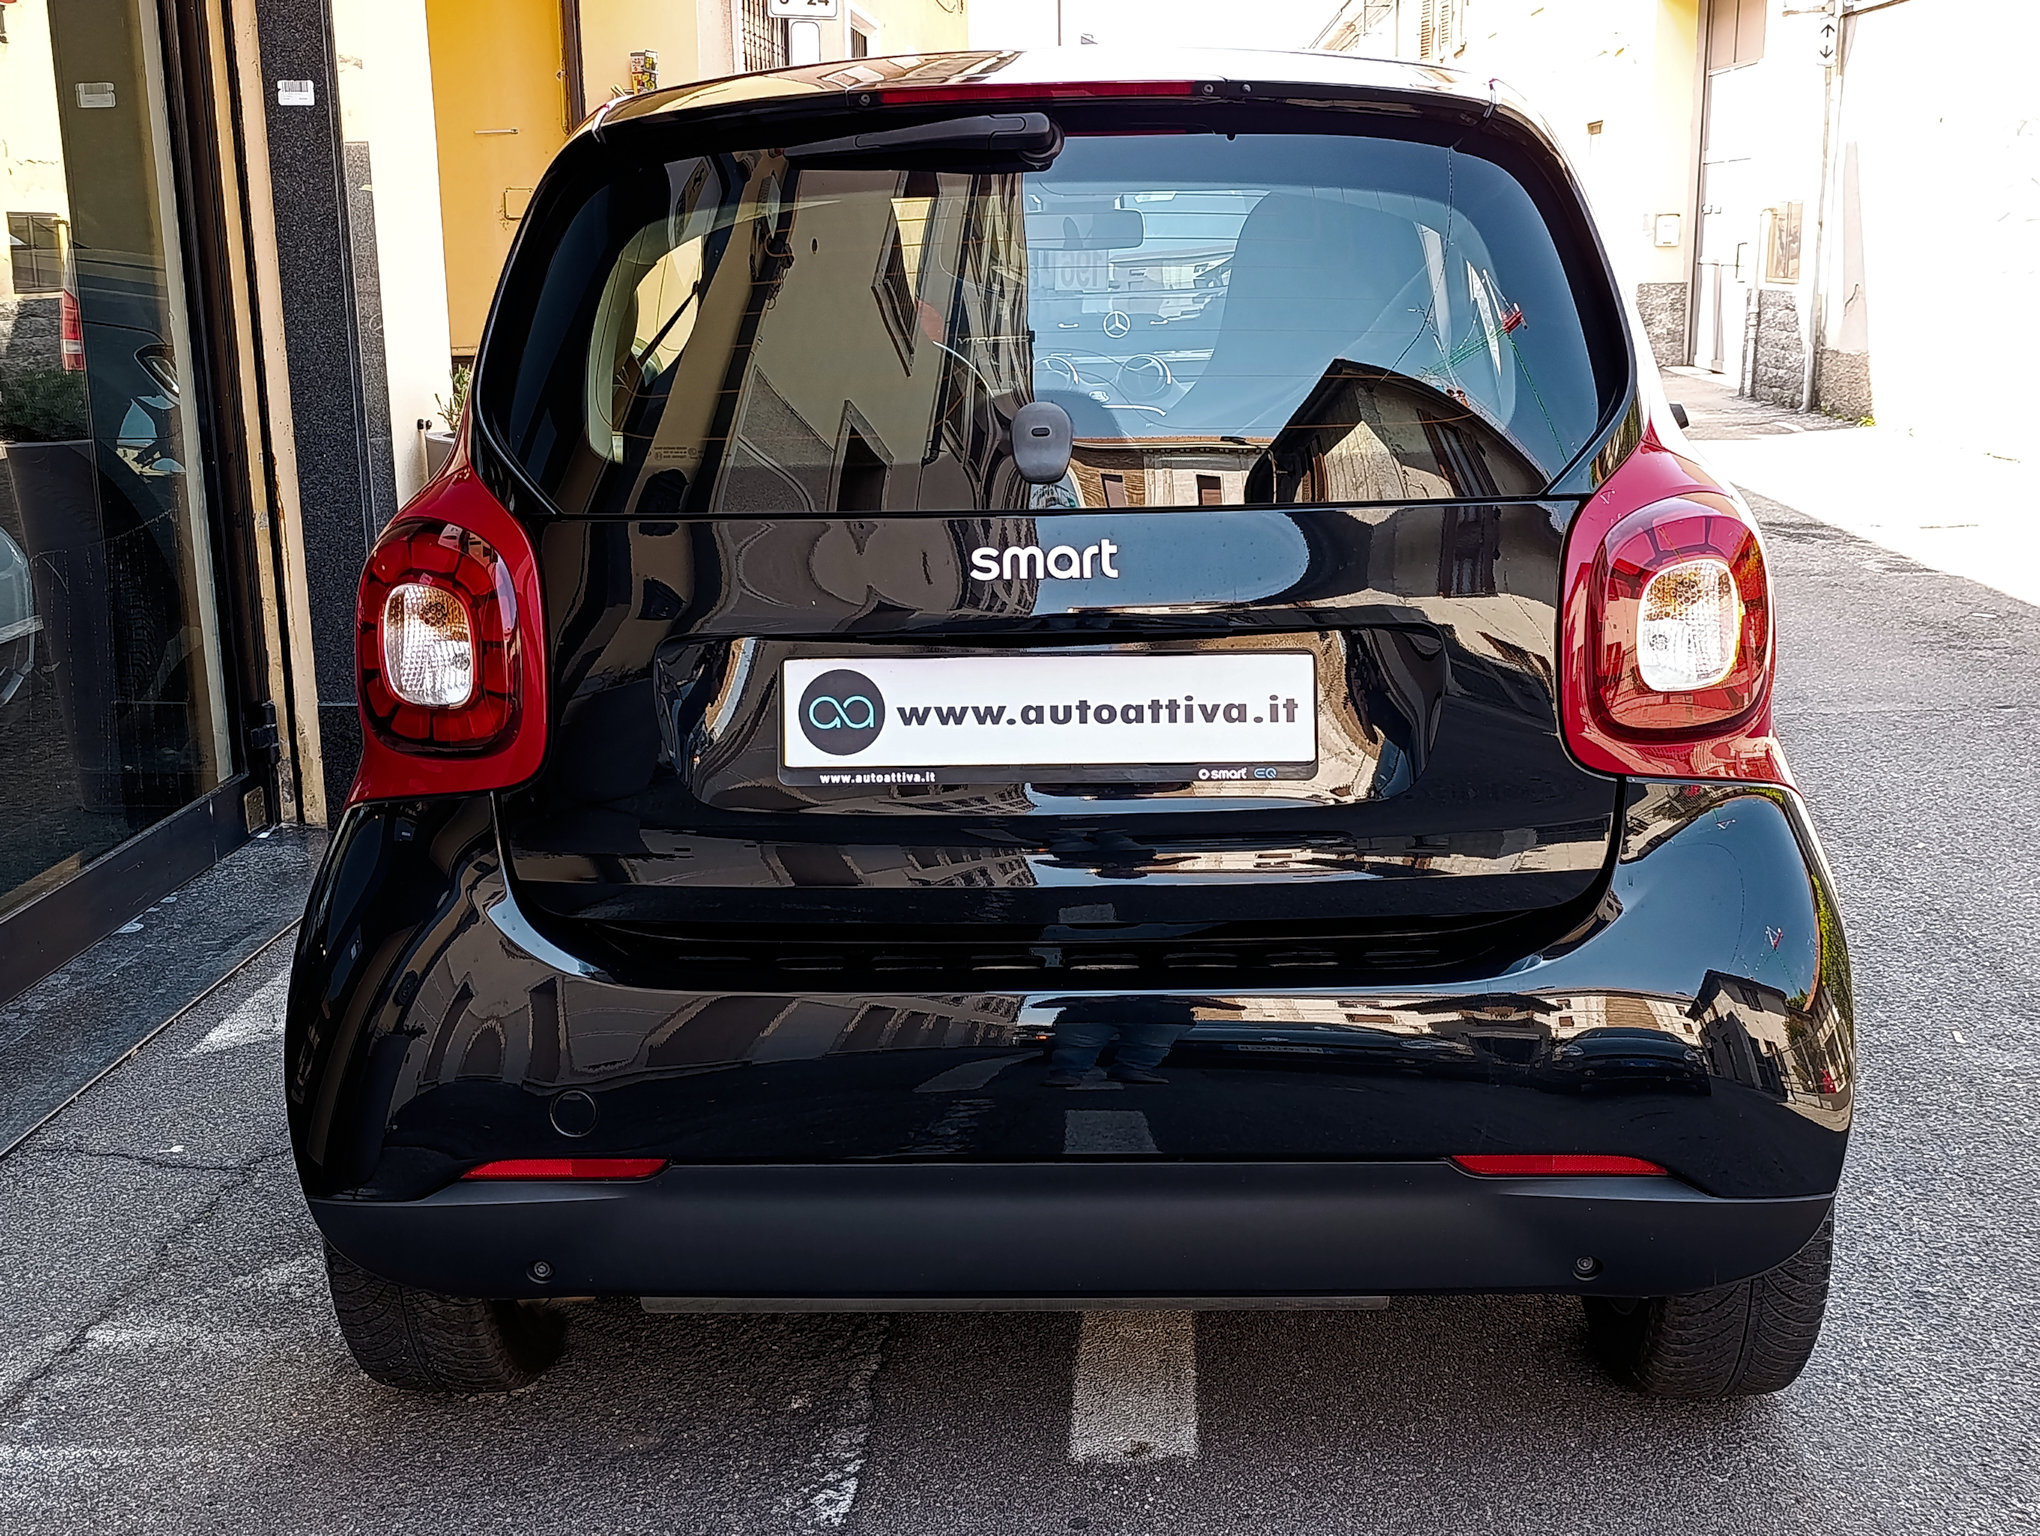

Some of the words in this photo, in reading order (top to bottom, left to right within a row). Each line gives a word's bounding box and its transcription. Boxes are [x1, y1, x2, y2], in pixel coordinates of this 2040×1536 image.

[970, 538, 1119, 581] smart
[896, 695, 1299, 726] www.autoattiva.it
[820, 771, 936, 784] www.autoattiva.it
[1211, 767, 1247, 780] smart
[1254, 767, 1277, 780] EQ
